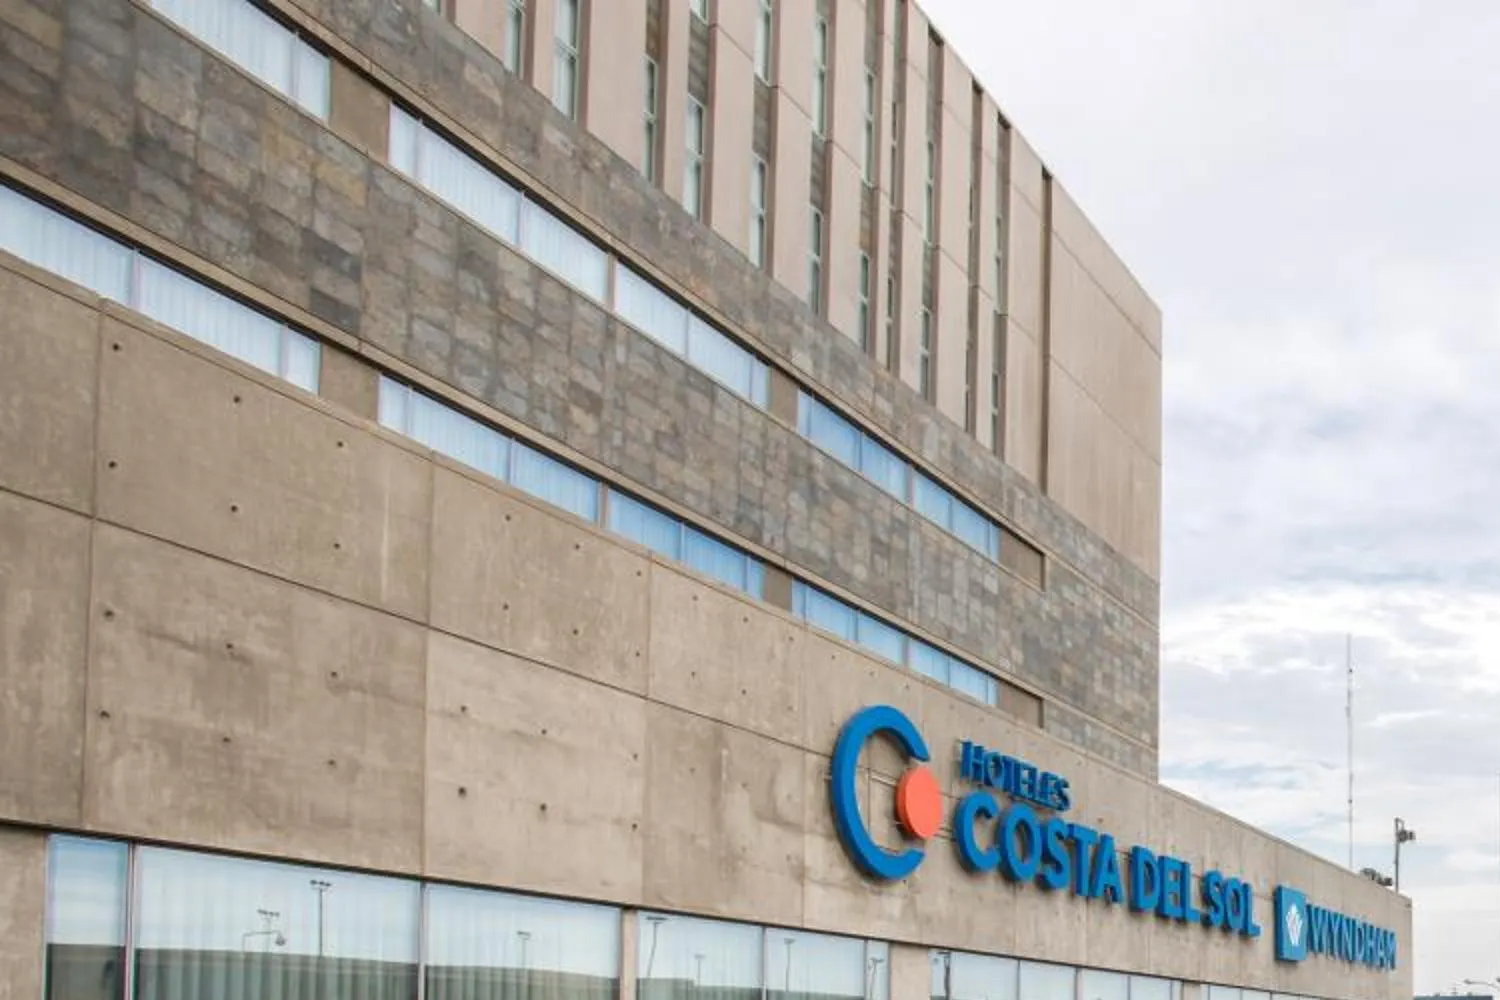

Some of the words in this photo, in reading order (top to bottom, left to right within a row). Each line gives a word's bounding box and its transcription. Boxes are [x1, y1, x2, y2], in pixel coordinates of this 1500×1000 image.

[960, 740, 1070, 812] HOTELES
[954, 791, 1122, 904] COSTA
[1132, 845, 1201, 923] DEL
[1203, 869, 1261, 938] SOL
[1306, 903, 1396, 971] WYNDHAM
